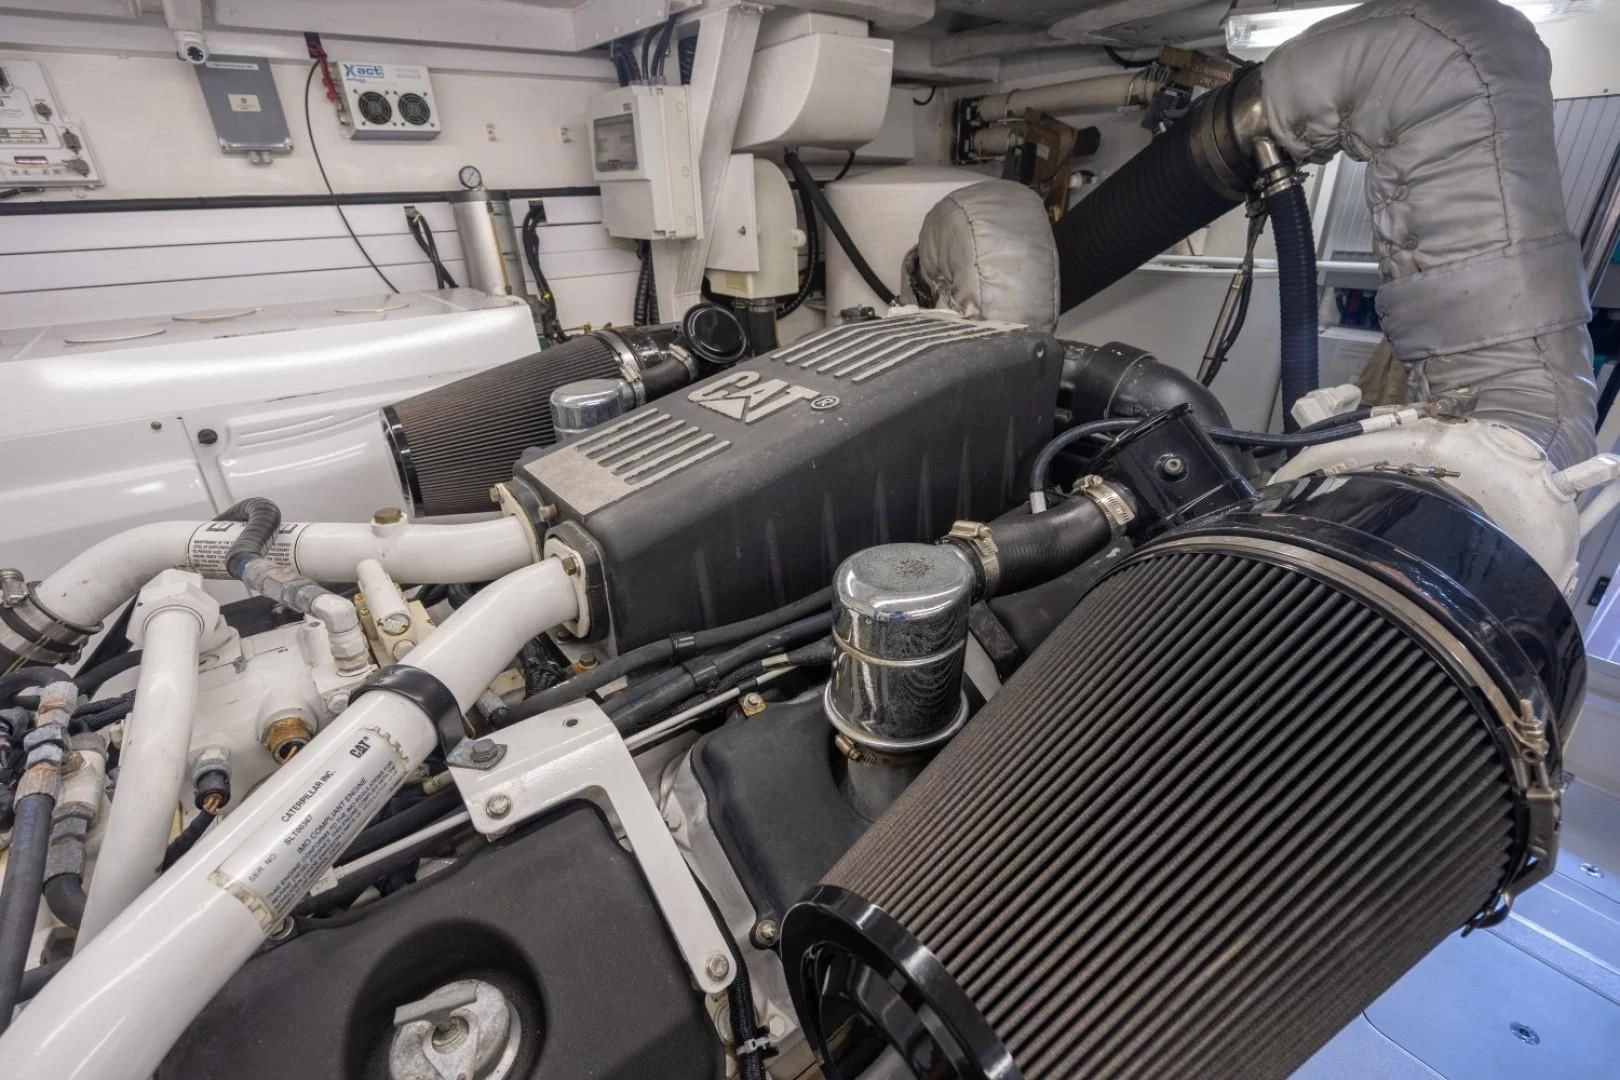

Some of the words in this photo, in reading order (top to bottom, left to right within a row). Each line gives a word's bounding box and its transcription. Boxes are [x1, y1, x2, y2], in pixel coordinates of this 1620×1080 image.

[343, 64, 382, 78] Xact
[281, 781, 323, 823] CATERPILLAR
[310, 801, 346, 840] COMPLIANT
